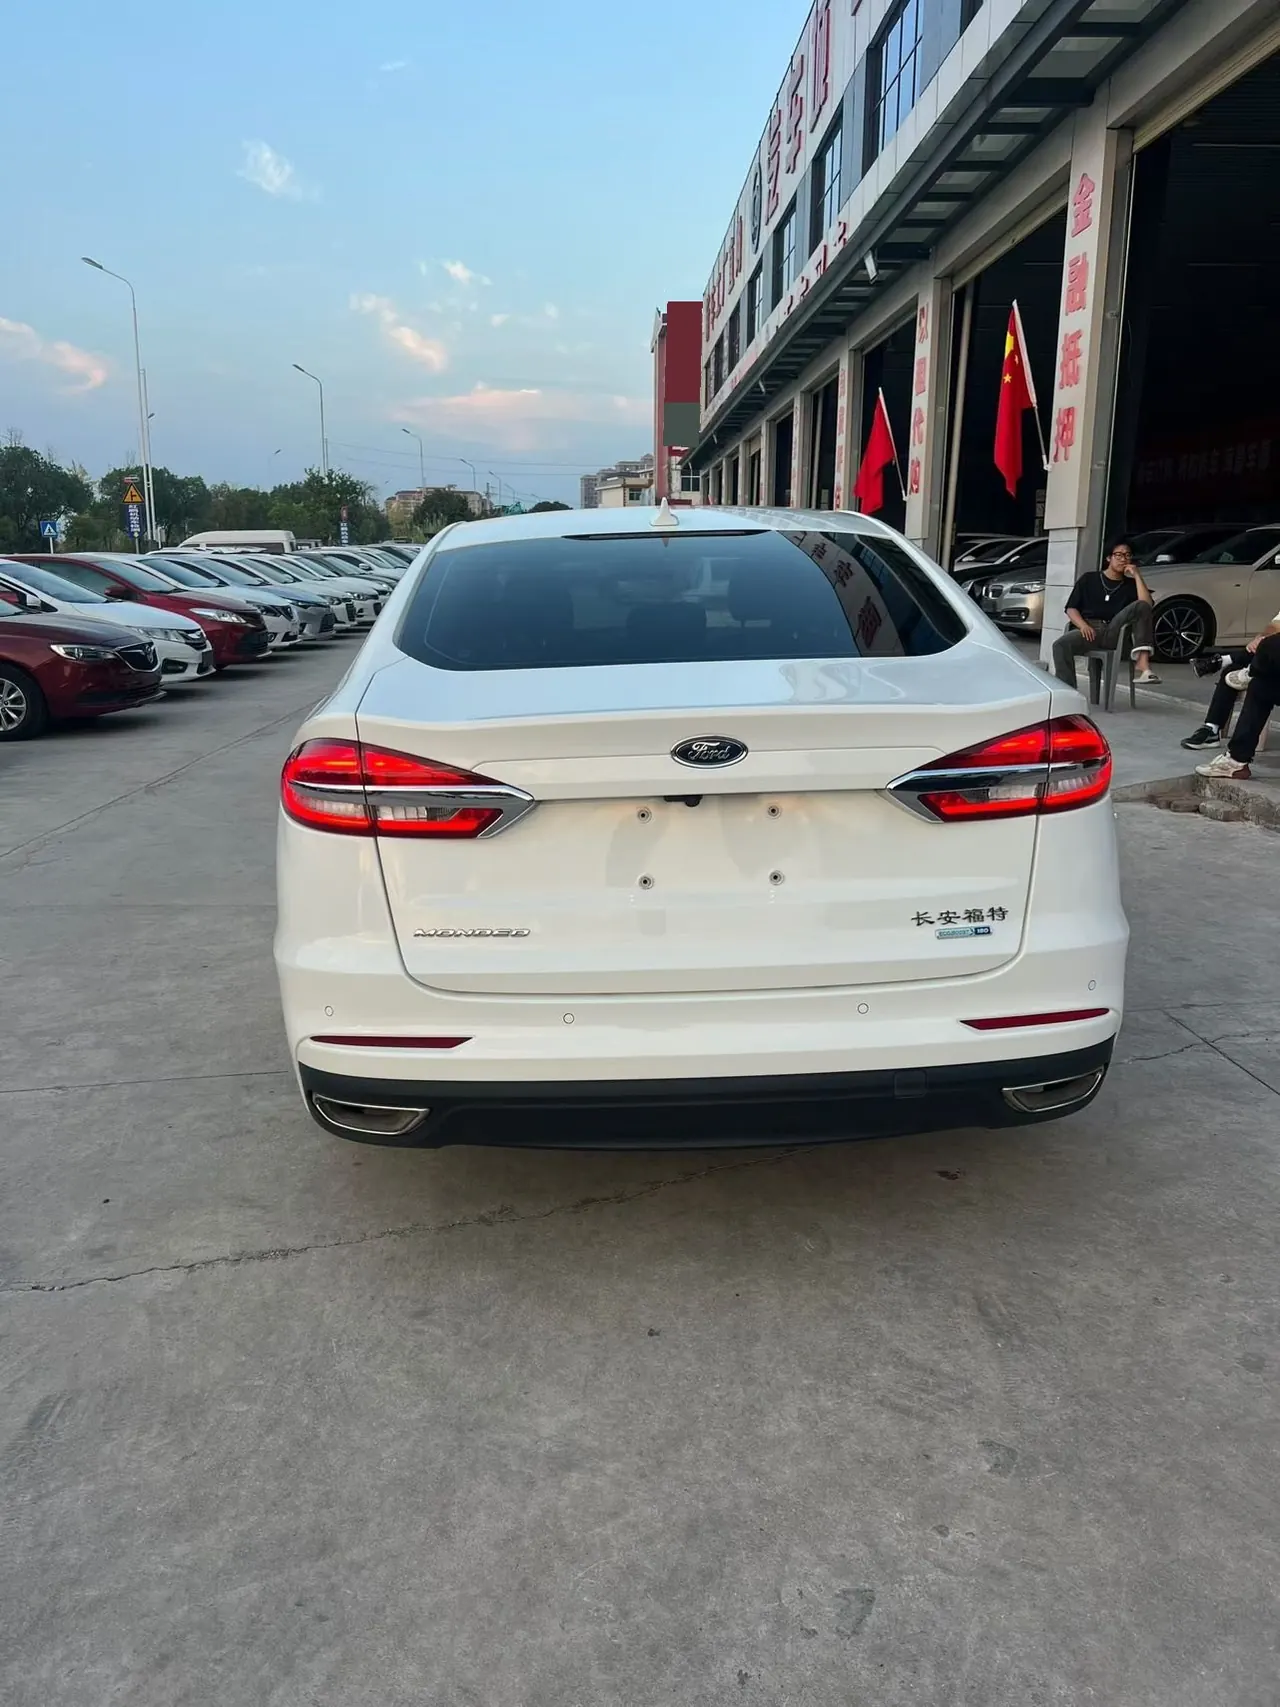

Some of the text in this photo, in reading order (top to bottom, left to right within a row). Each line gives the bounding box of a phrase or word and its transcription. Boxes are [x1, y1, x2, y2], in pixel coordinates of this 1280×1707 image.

[1053, 172, 1096, 463] 金融抵押
[687, 741, 731, 761] Ford
[911, 906, 1009, 926] 长安福特
[413, 928, 531, 938] MONDEO
